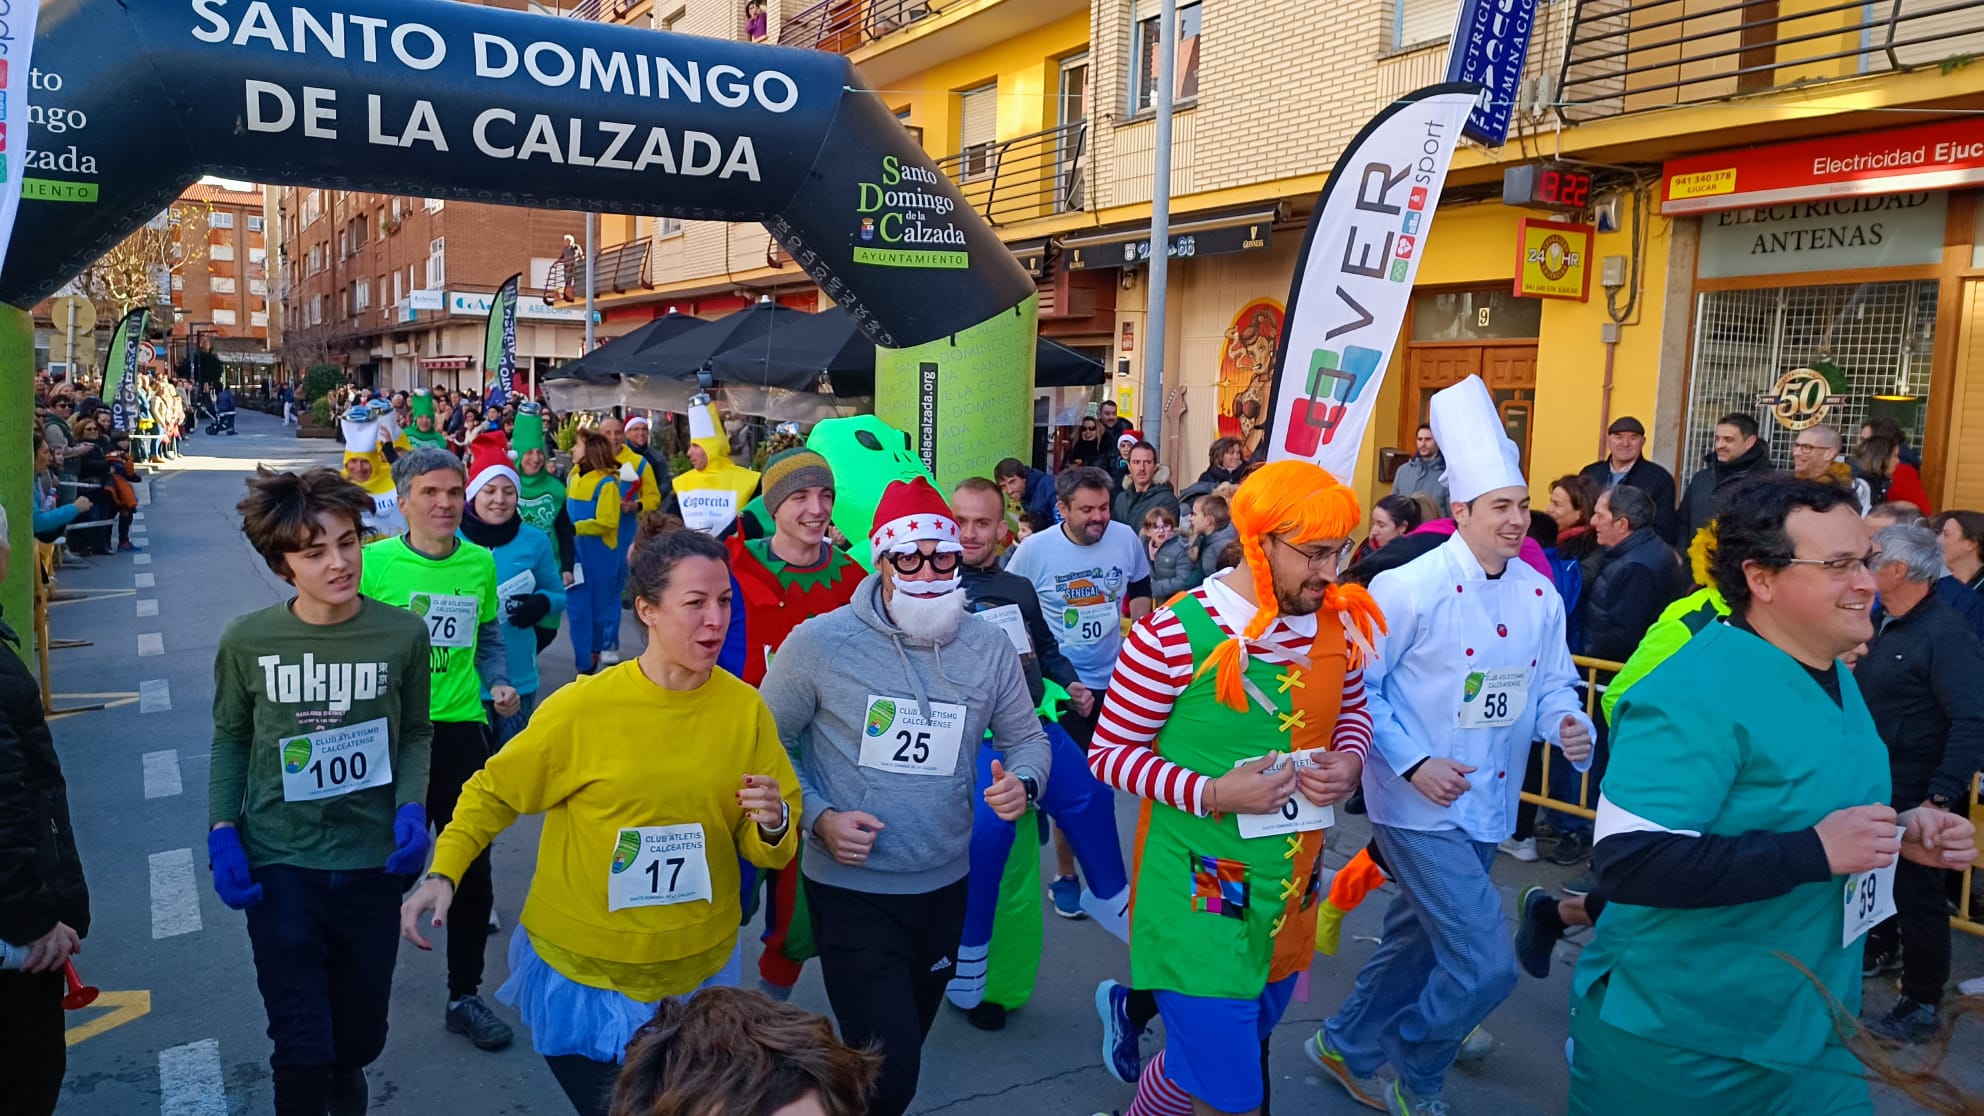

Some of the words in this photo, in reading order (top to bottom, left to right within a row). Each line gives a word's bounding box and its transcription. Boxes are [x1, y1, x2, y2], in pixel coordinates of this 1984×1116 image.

[191, 0, 446, 70] SANTO
[473, 32, 799, 114] DOMINGO
[245, 79, 337, 140] DE
[367, 93, 450, 152] LA
[472, 107, 762, 183] CALZADA
[1415, 119, 1445, 184] sport
[1813, 145, 1926, 176] Electricidad
[882, 155, 937, 185] Santo
[1675, 177, 1692, 186] 941
[1696, 174, 1712, 183] 340
[857, 183, 954, 215] Domingo
[880, 212, 966, 245] Calzada
[906, 210, 917, 221] de
[1751, 223, 1883, 255] ANTENAS
[862, 251, 963, 265] AYUNTAMIENTO
[1528, 248, 1545, 263] 24
[1561, 252, 1580, 268] HR
[1479, 308, 1489, 324] 9
[1776, 379, 1828, 417] 50
[1065, 585, 1099, 599] SENEGAL
[431, 615, 457, 639] 76
[1082, 620, 1102, 639] 50
[258, 652, 378, 712] Tokyo
[900, 707, 918, 716] CLUB
[1484, 692, 1507, 719] 58
[315, 736, 337, 746] CLUB
[338, 726, 380, 743] ATLETISMO
[321, 735, 375, 754] CALCEATENSE
[892, 730, 931, 764] 25
[309, 751, 367, 789] 100
[645, 834, 667, 843] CLUB
[645, 857, 686, 893] 17
[1859, 872, 1877, 919] 59
